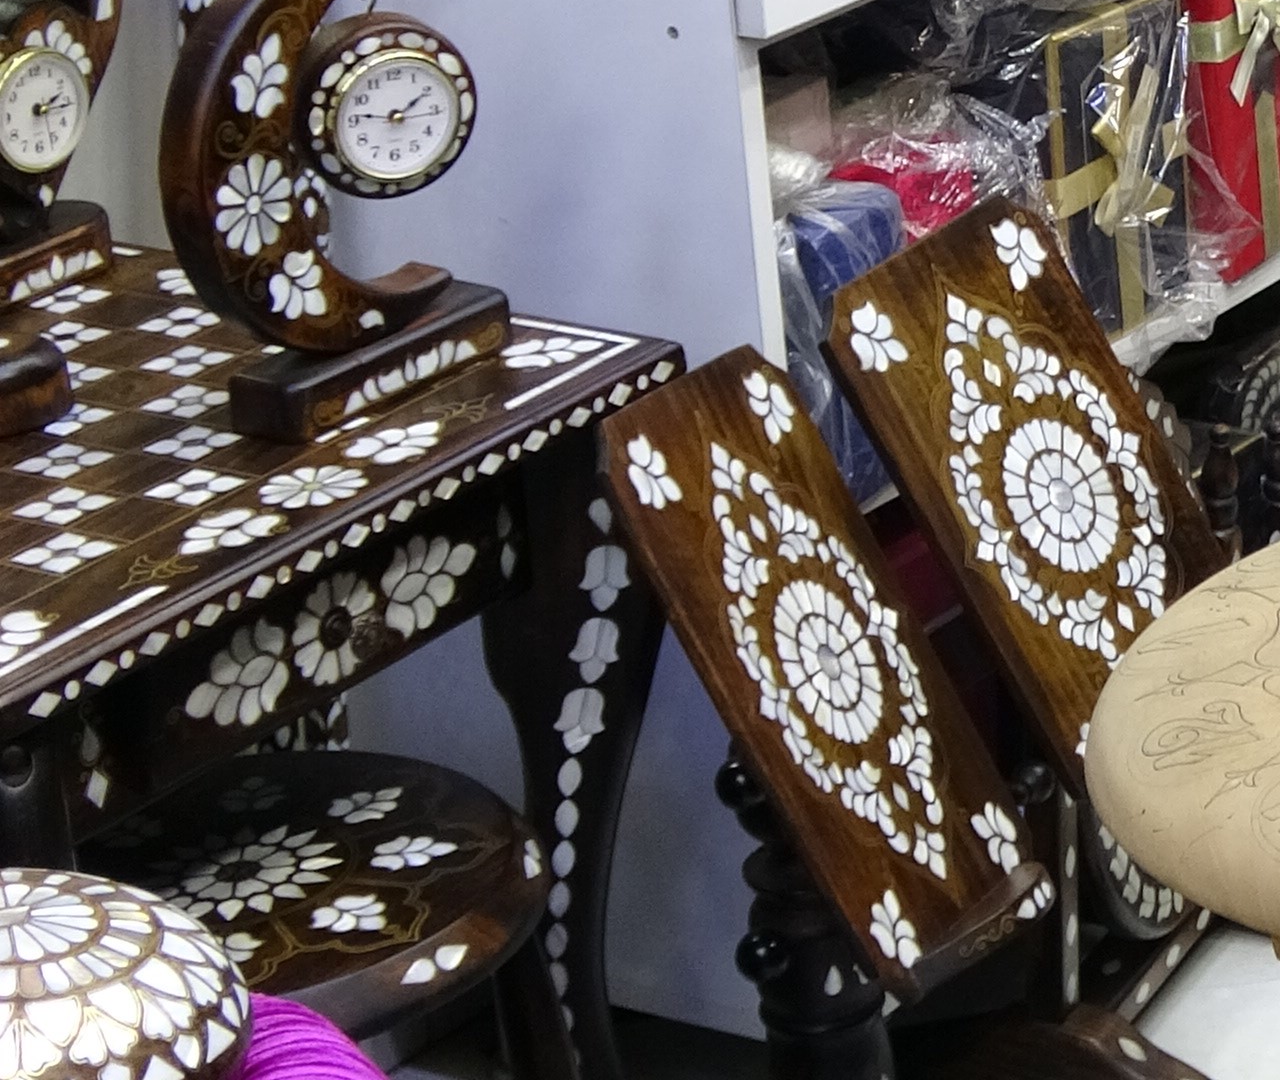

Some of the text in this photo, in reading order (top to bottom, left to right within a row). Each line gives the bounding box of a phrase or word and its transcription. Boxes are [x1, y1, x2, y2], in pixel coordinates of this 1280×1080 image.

[28, 66, 40, 78] 12
[386, 69, 402, 81] 12
[367, 78, 381, 90] 11
[421, 85, 432, 97] 2
[354, 93, 369, 106] 10
[428, 104, 440, 116] 3
[348, 114, 360, 129] 9
[422, 125, 433, 137] 4
[21, 139, 28, 153] 7
[356, 132, 368, 147] 8
[35, 140, 44, 153] 6
[370, 145, 380, 159] 7
[408, 140, 420, 153] 5
[389, 148, 401, 161] 6
